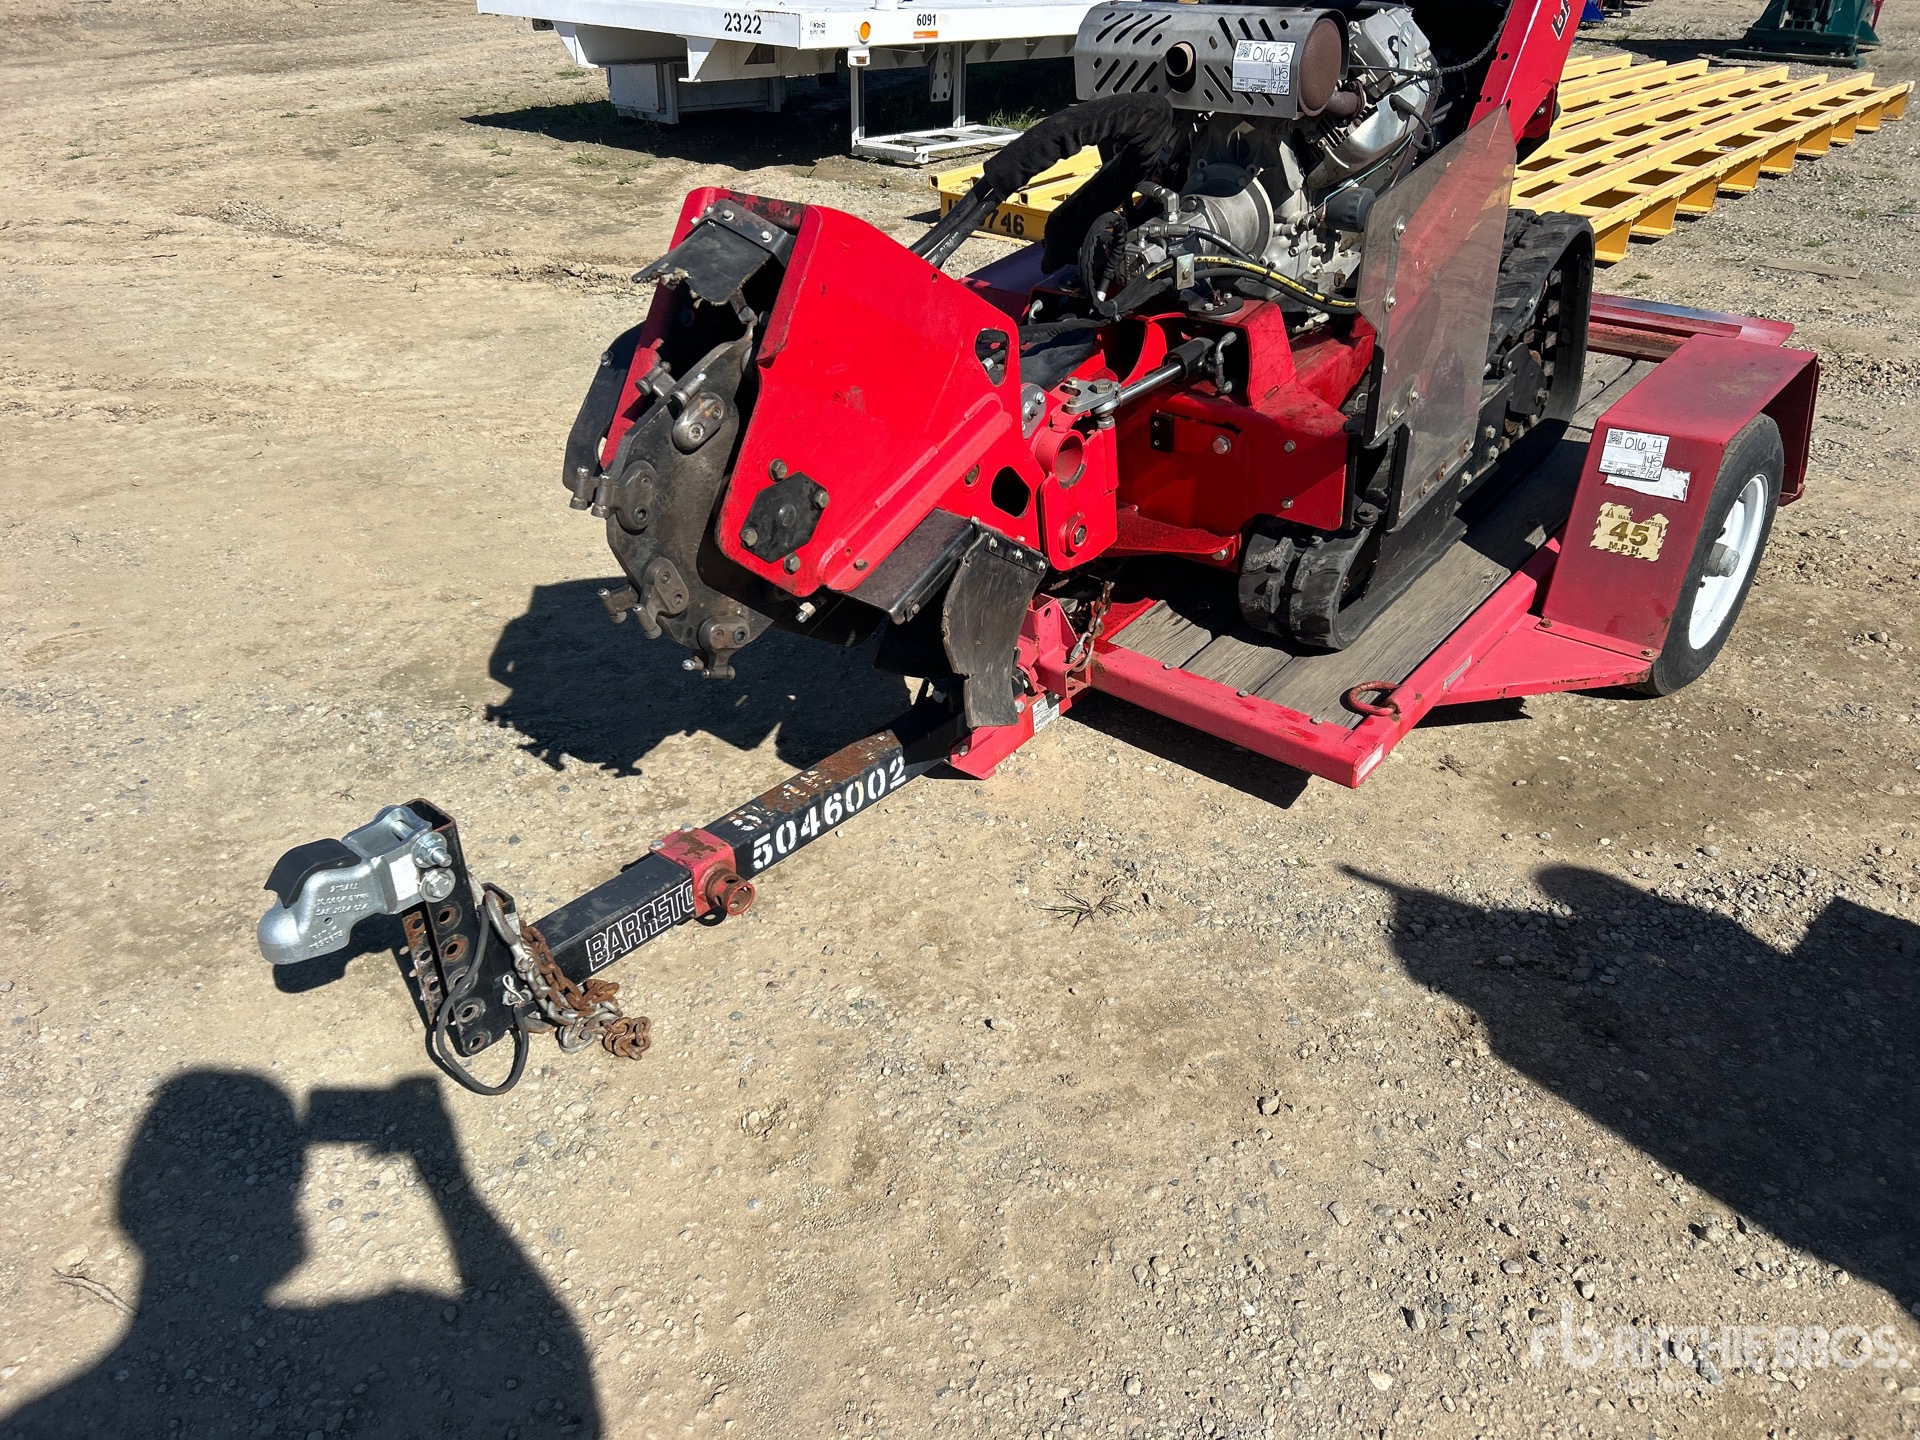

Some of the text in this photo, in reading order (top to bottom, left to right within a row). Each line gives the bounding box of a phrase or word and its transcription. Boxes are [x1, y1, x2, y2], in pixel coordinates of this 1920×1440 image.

[724, 12, 762, 34] 2322
[916, 13, 937, 26] 6091
[1272, 65, 1289, 81] 145
[980, 209, 1025, 235] 746
[1609, 521, 1650, 547] 45
[1608, 541, 1642, 556] M.P.H.
[753, 756, 907, 870] 5046002
[585, 879, 695, 972] BARRETO
